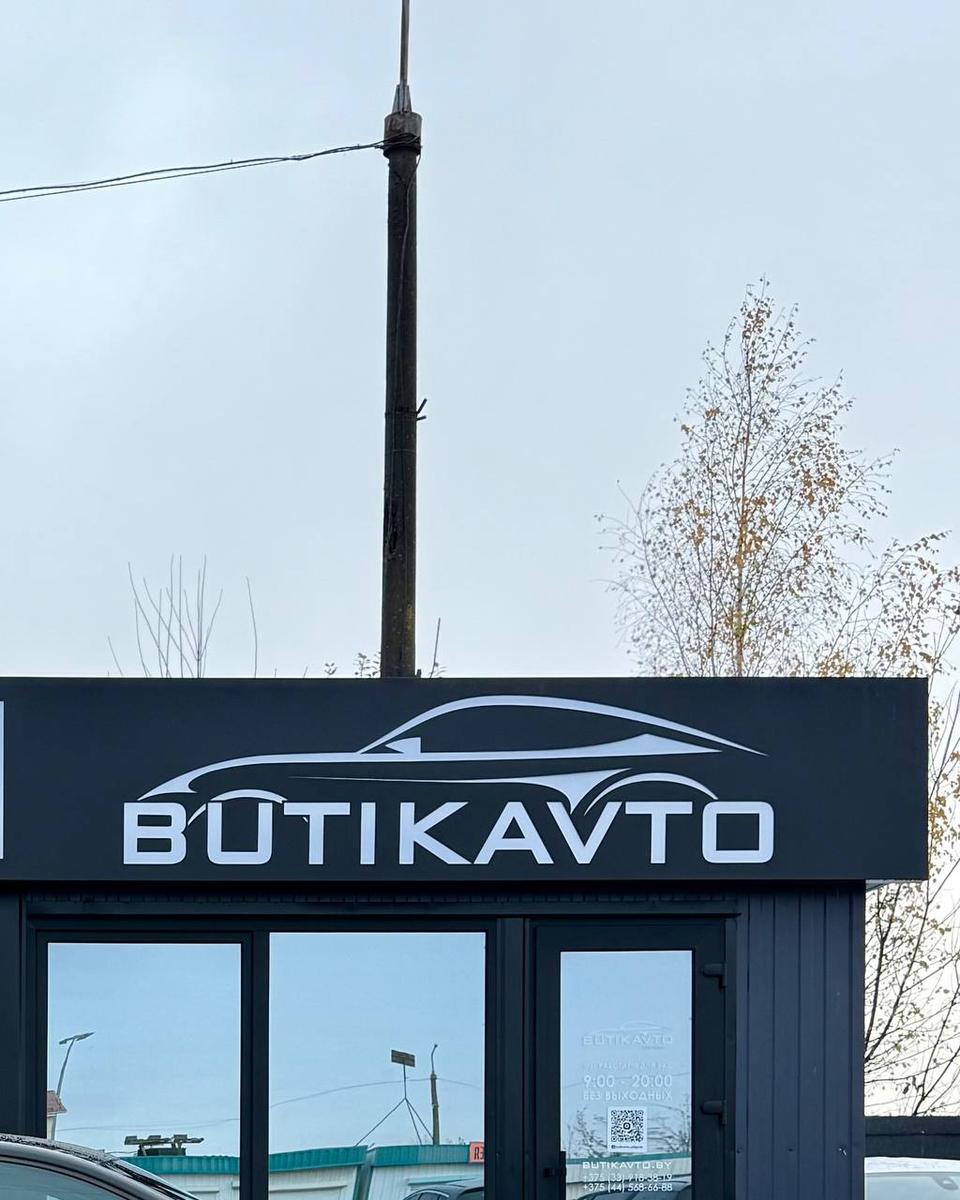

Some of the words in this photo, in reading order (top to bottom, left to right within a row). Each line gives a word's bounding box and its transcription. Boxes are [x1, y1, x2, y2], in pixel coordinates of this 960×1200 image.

[123, 800, 775, 866] BUTIKAVTO
[583, 1074, 615, 1088] 9:00
[631, 1074, 673, 1088] 20:00
[605, 1090, 673, 1102] ВЫХОДНЫХ
[582, 1161, 672, 1169] BUTIKAVTO.BY
[583, 1183, 605, 1192] +375
[607, 1183, 625, 1193] (44)
[627, 1183, 673, 1192] 568-66-88
